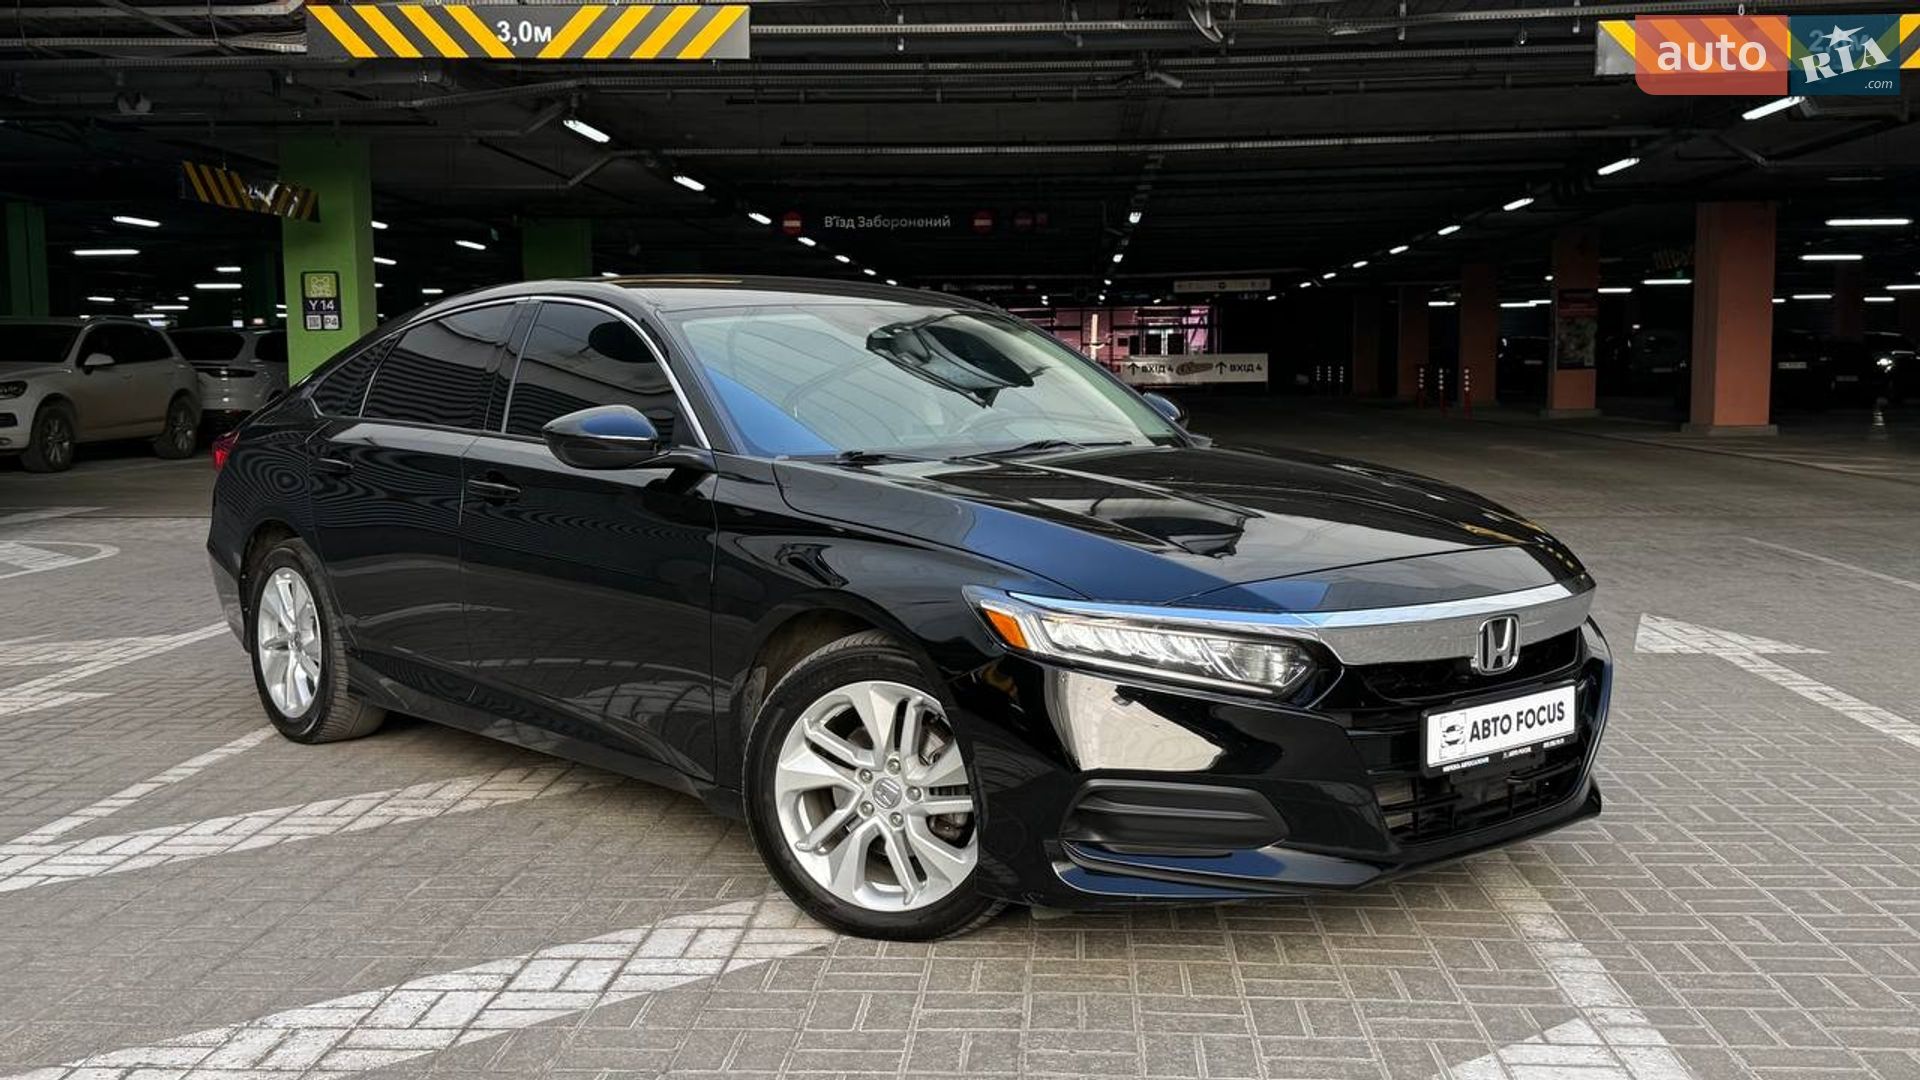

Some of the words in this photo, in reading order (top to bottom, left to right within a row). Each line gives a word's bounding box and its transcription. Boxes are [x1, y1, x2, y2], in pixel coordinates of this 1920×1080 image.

[497, 20, 552, 46] 3,0м
[857, 214, 951, 230] Заборонений
[1516, 701, 1565, 731] FOCUS
